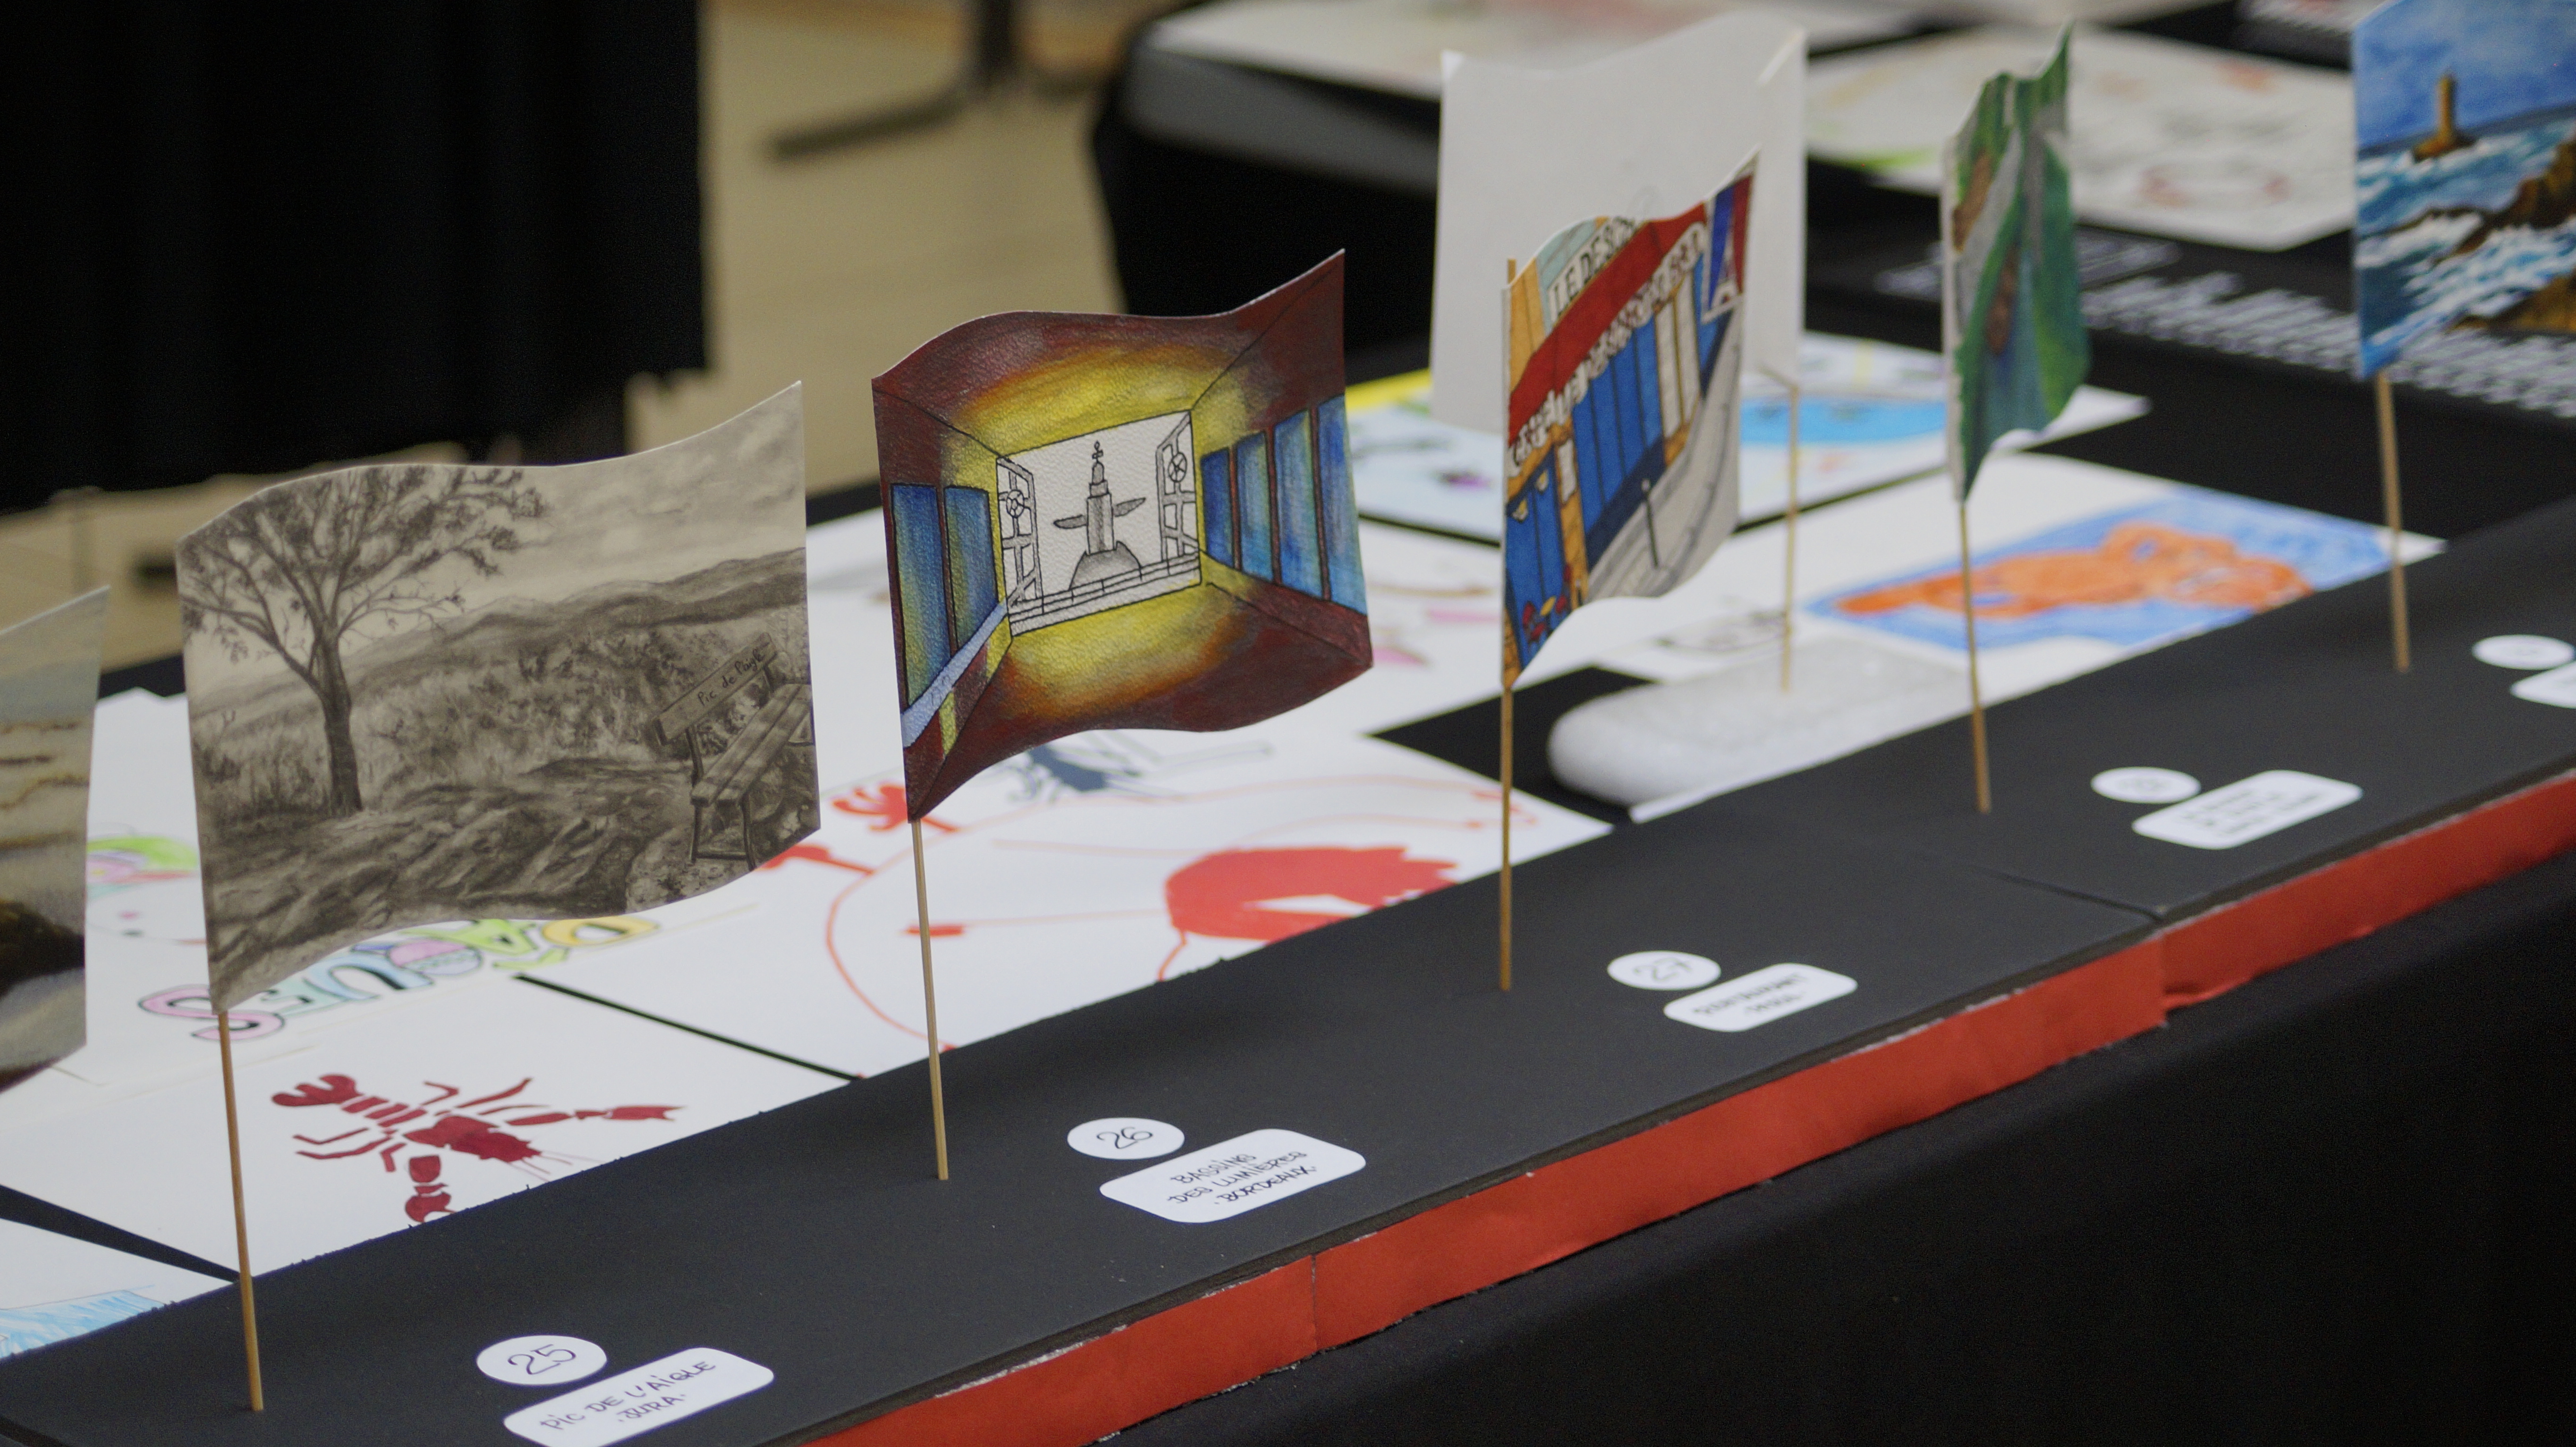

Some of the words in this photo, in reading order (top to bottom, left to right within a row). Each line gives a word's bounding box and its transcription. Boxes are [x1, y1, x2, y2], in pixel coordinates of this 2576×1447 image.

[697, 691, 717, 707] Pic
[721, 675, 737, 689] de
[1632, 956, 1694, 982] 27
[1096, 1125, 1153, 1149] 26
[1167, 1186, 1213, 1204] DES
[507, 1343, 576, 1375] 25
[584, 1396, 625, 1413] DE
